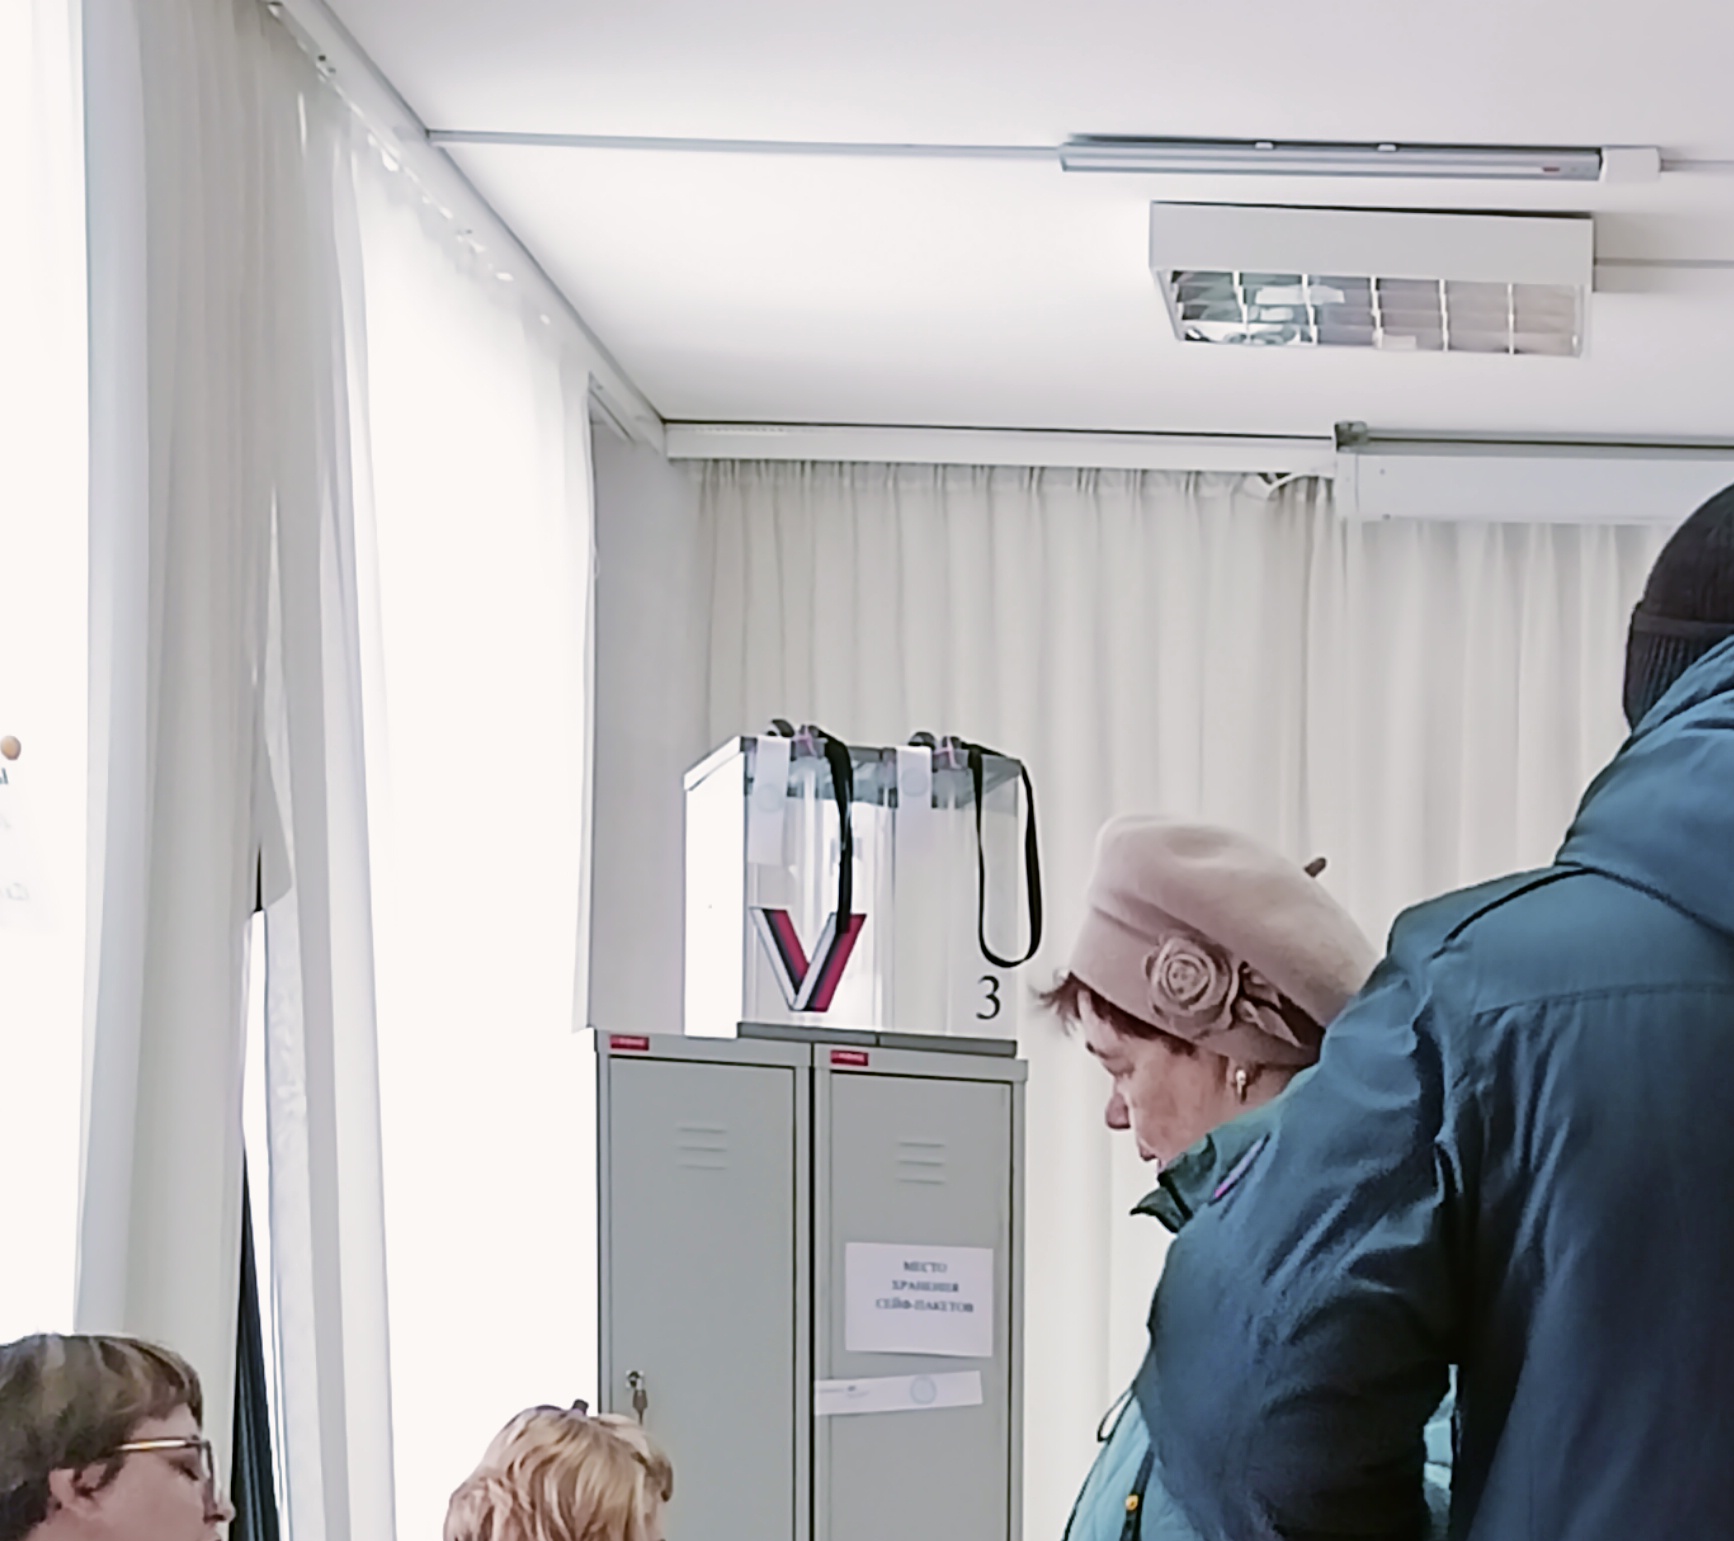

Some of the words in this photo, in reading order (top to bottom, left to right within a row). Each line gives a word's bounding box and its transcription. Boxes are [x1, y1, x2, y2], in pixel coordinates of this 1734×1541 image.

[976, 975, 1001, 1020] 3
[903, 1261, 947, 1273] МЕСТО
[892, 1280, 959, 1292] ХРАНЕНИЯ
